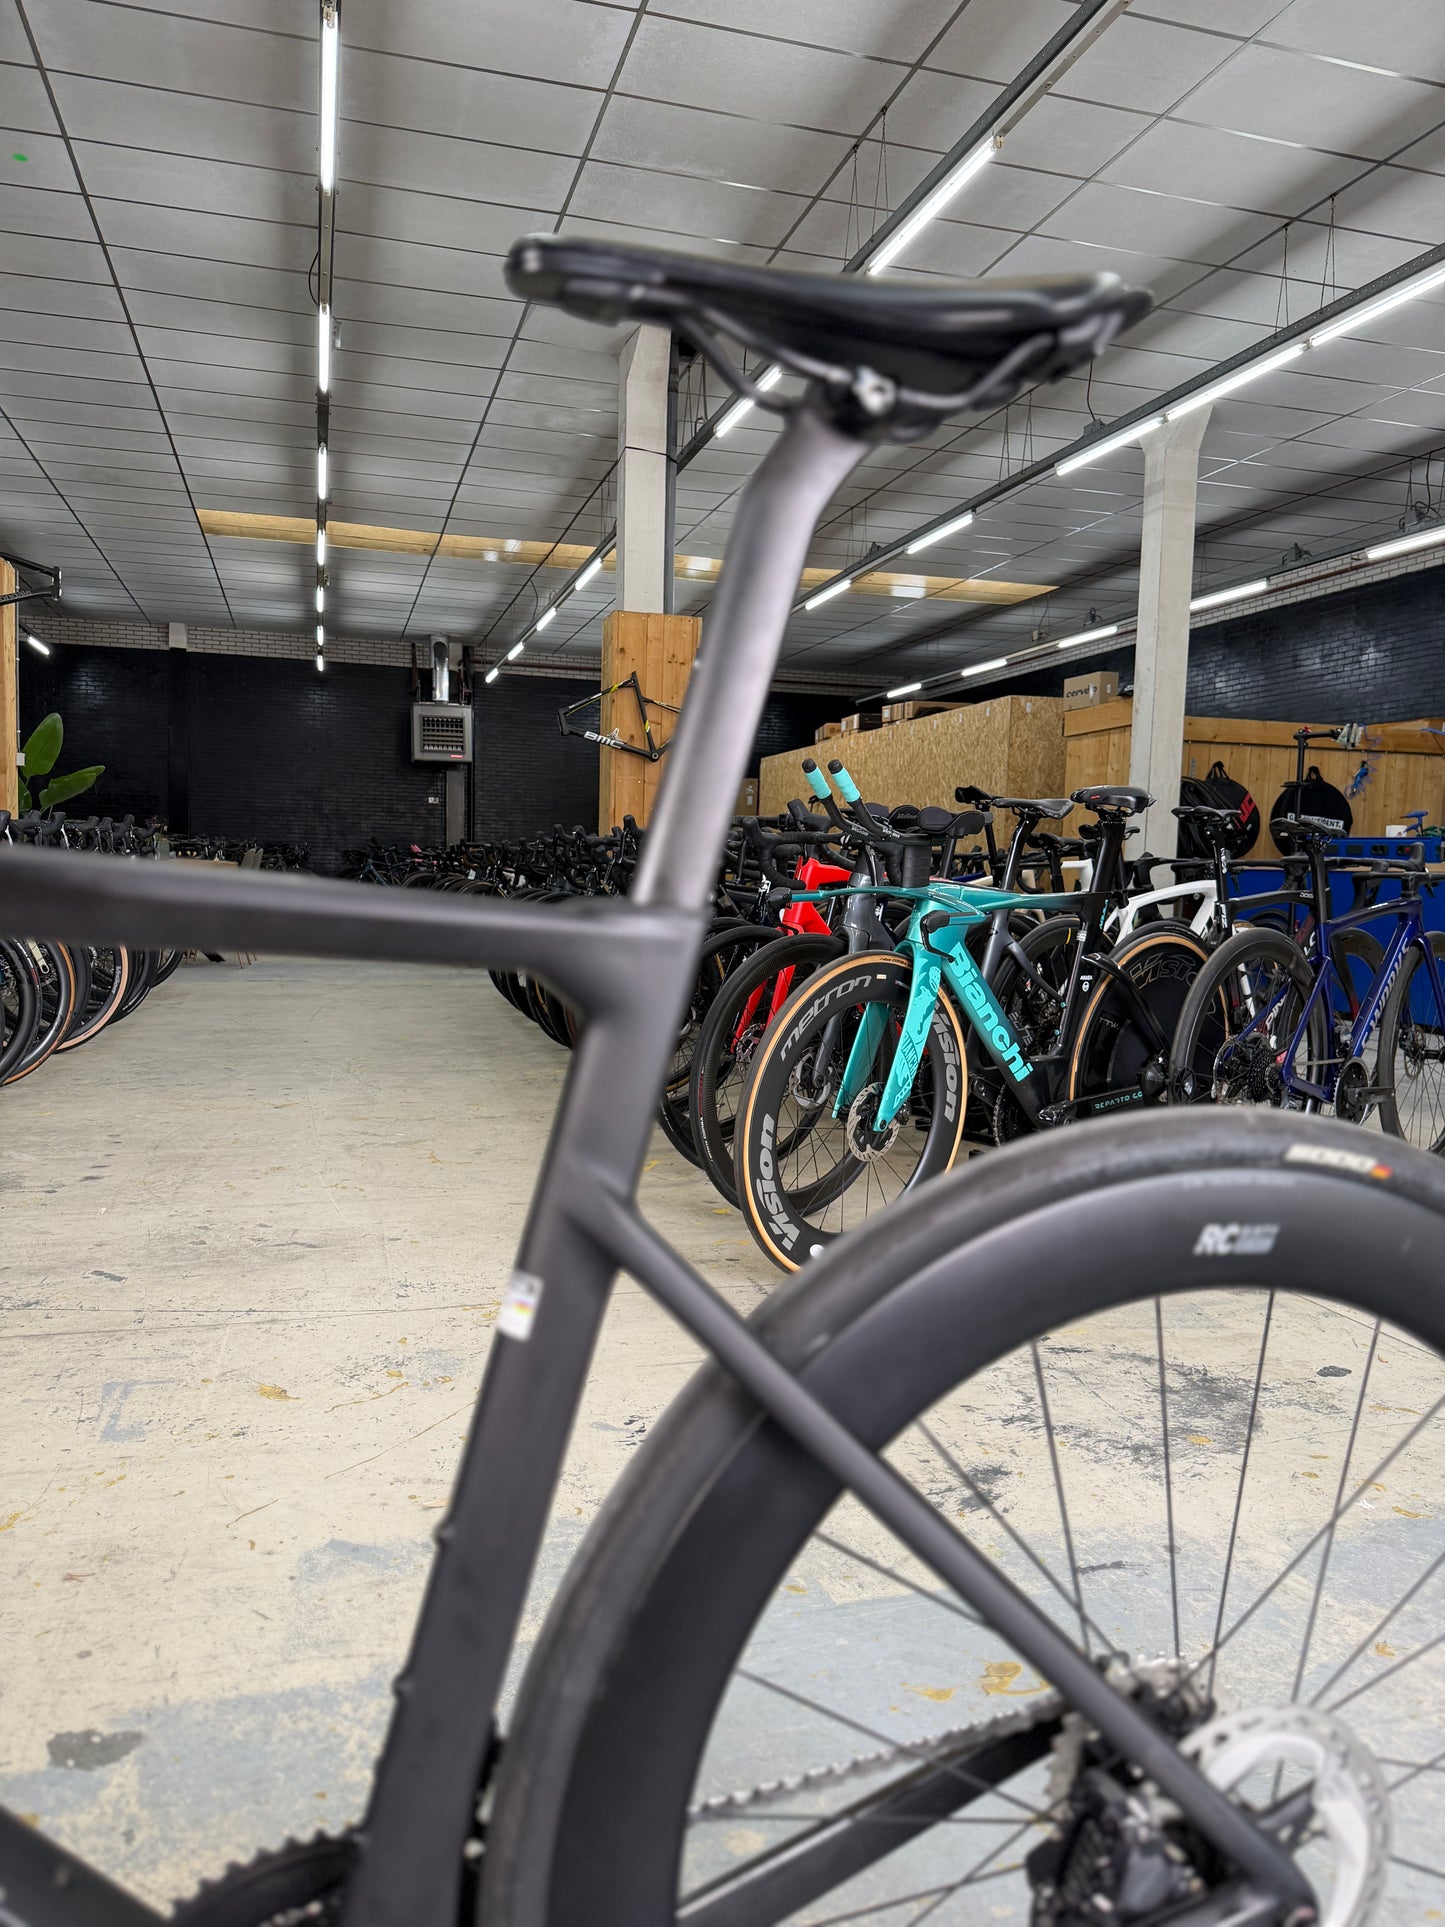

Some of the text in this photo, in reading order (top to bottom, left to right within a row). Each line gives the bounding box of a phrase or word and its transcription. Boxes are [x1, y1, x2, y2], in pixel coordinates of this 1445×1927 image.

[583, 731, 625, 749] BMC
[780, 975, 872, 1061] metron
[948, 942, 1034, 1082] Bianchi
[756, 1113, 800, 1251] Vision
